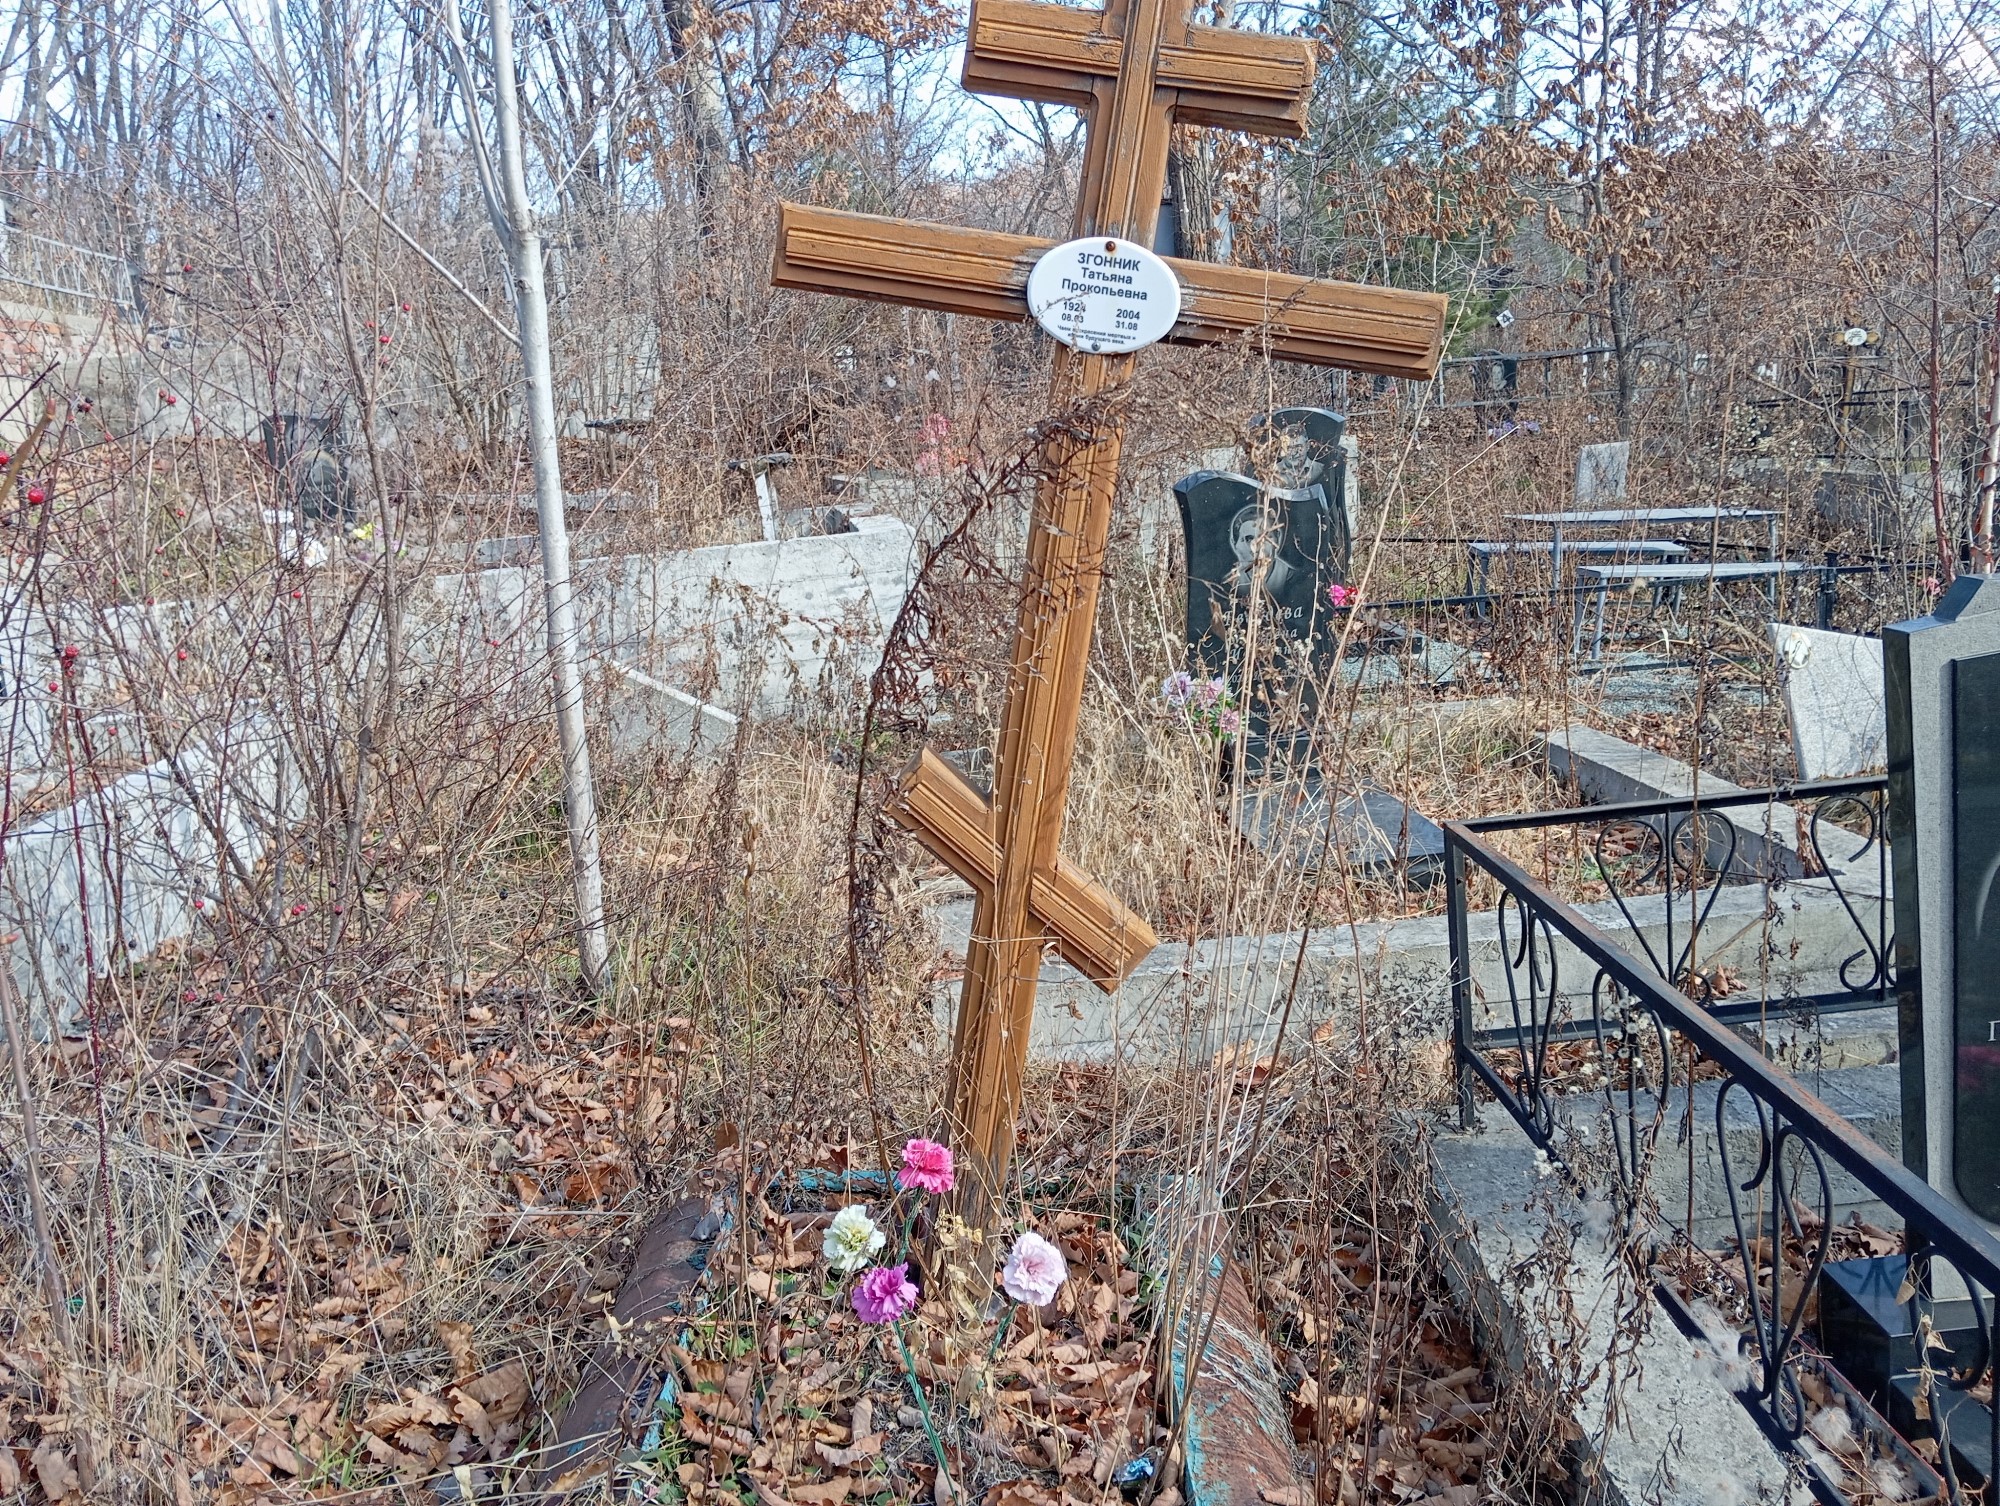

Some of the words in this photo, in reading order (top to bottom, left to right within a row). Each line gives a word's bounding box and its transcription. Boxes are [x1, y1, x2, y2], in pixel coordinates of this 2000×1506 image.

[1078, 252, 1141, 271] ЗГОННИК
[1081, 267, 1133, 285] Татьяна
[1062, 278, 1148, 300] Прокопьевна
[1115, 308, 1141, 320] 2004
[1115, 320, 1138, 331] 31.08
